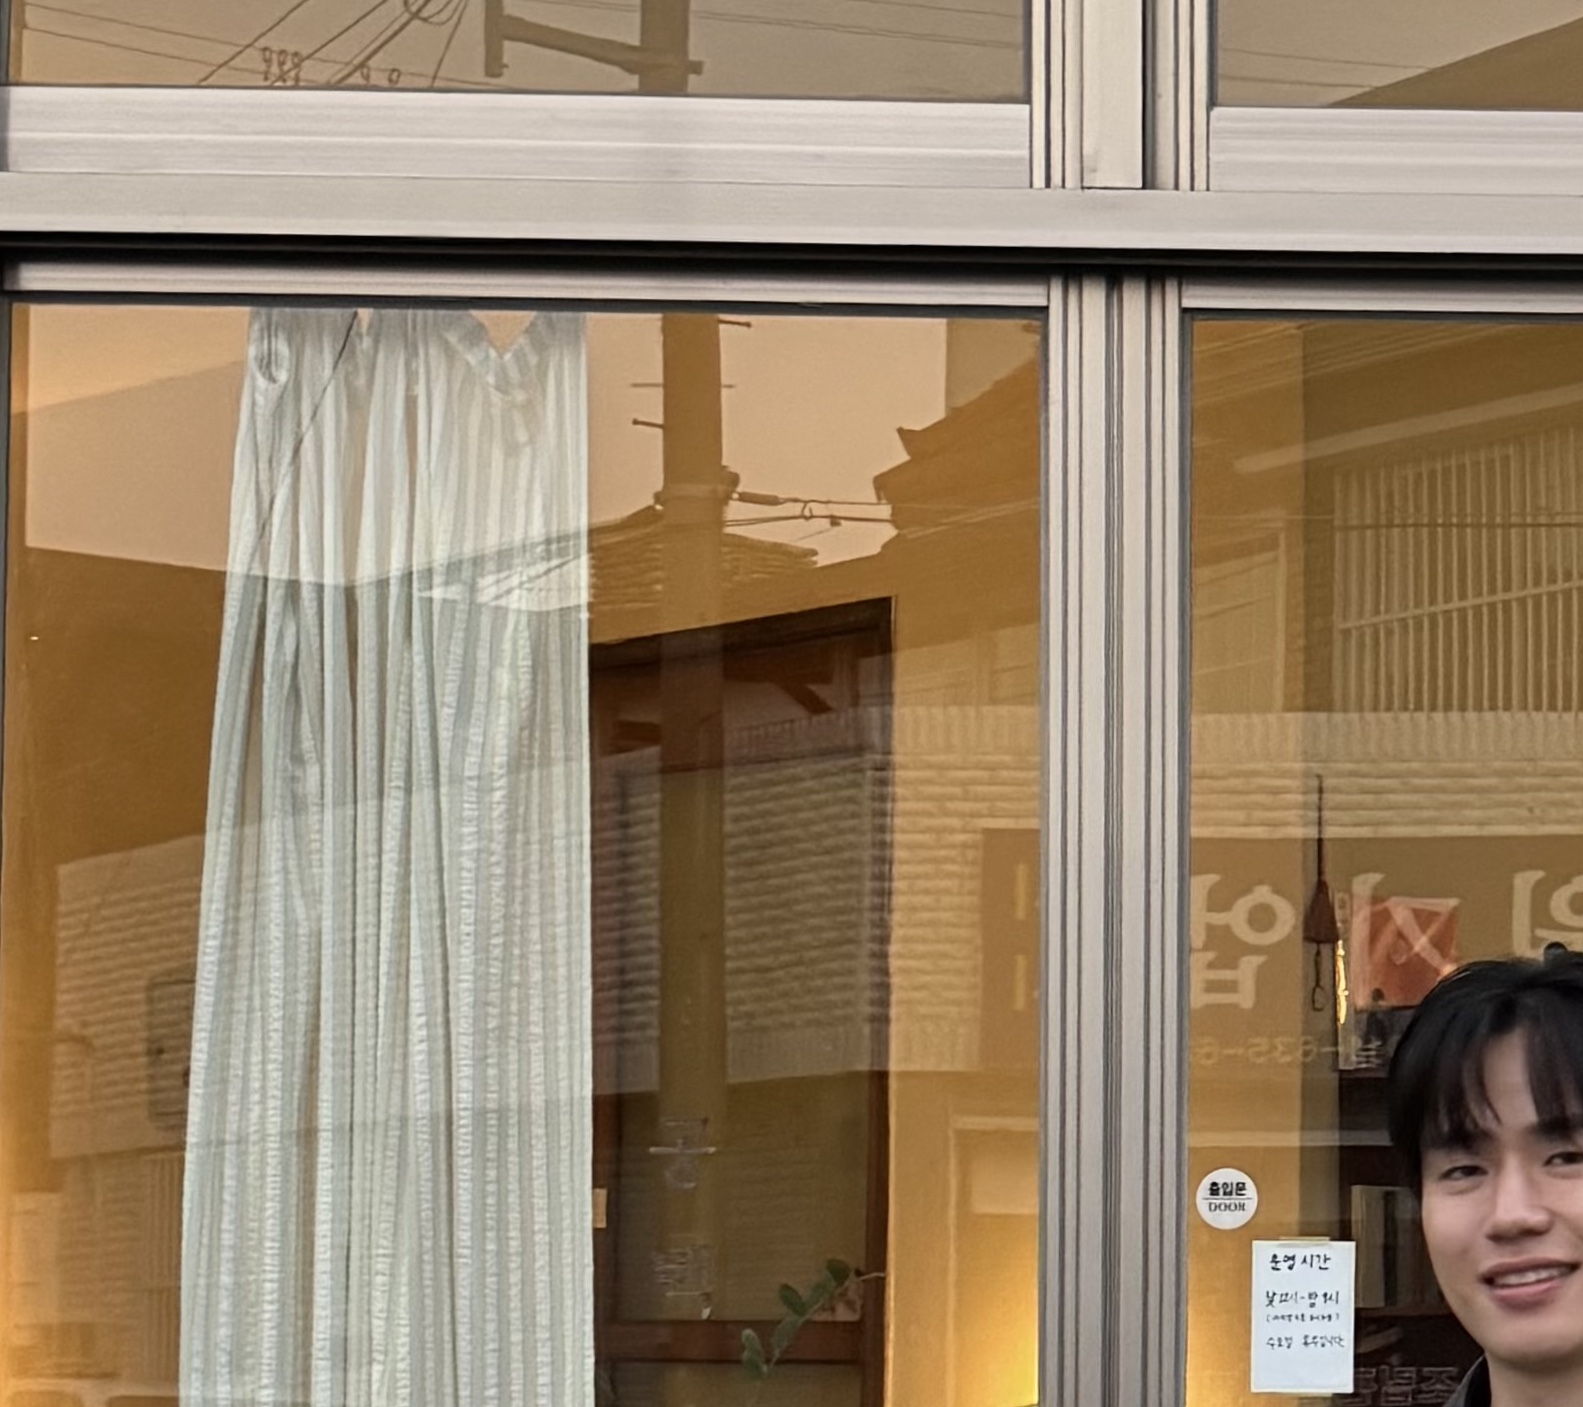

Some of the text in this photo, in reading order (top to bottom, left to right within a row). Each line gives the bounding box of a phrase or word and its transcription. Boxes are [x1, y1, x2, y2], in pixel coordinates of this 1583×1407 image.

[1208, 1181, 1247, 1197] 출입문
[1208, 1201, 1246, 1213] DOOR
[1269, 1253, 1331, 1271] 운영 시간
